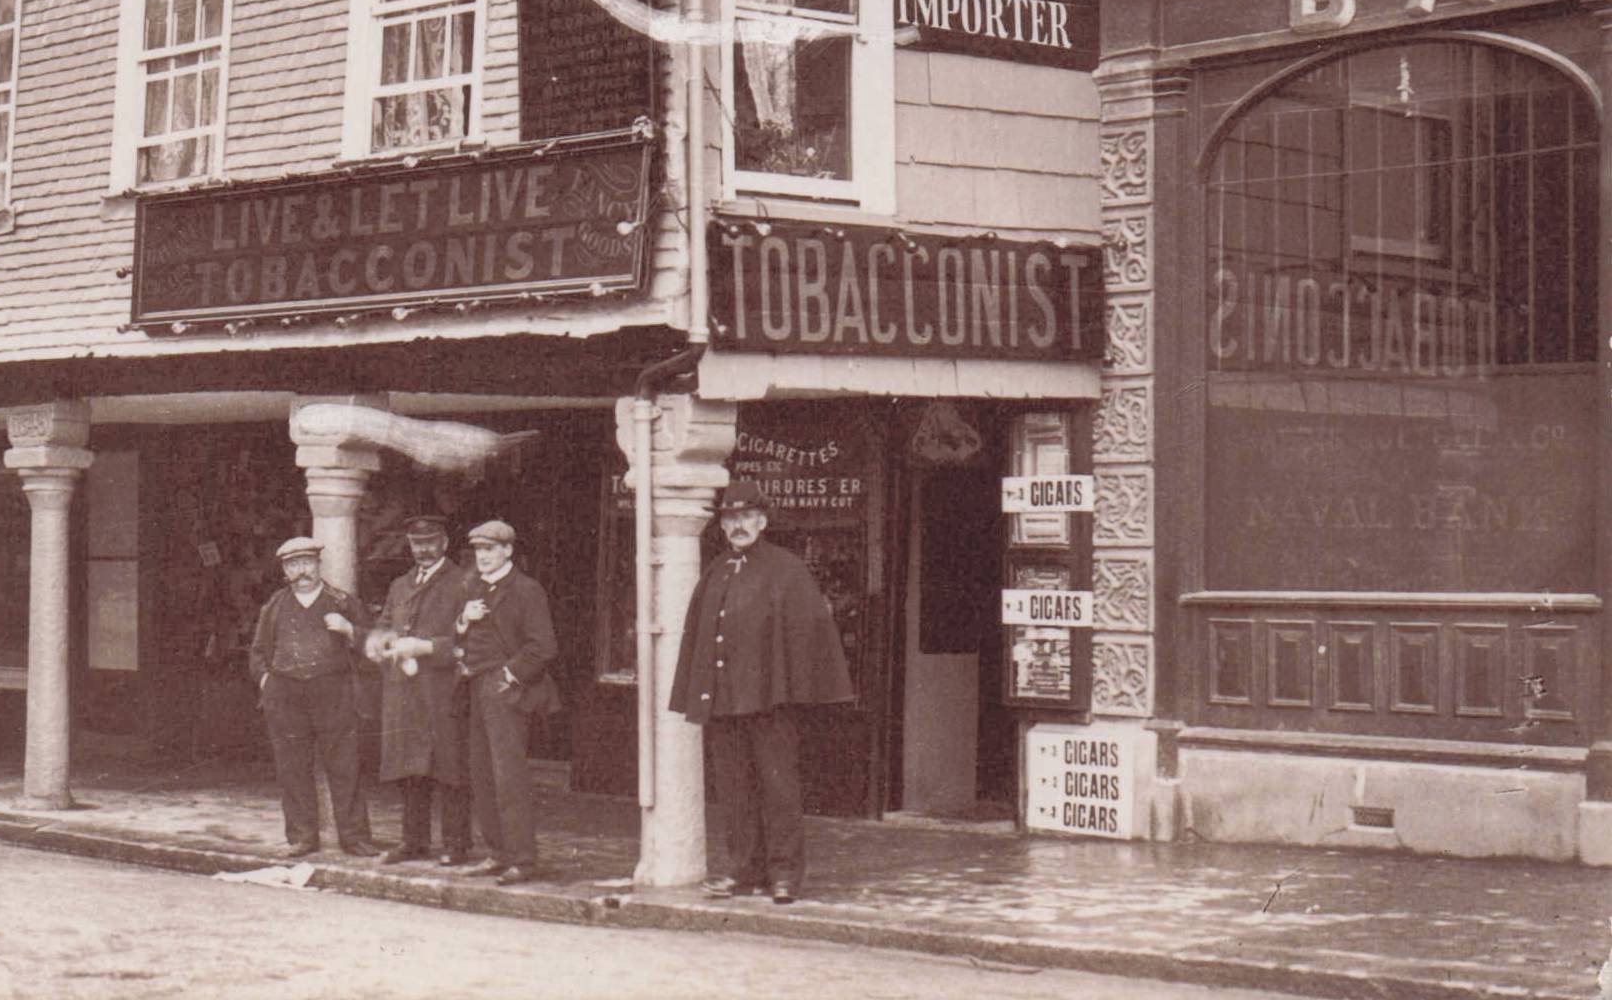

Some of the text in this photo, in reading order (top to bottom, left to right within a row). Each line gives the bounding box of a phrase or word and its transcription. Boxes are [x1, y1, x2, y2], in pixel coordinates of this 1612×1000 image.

[213, 197, 306, 250] LIVE
[311, 196, 341, 240] &
[350, 180, 439, 236] LET
[449, 163, 555, 228] LIVE
[194, 226, 575, 305] TOBACCONIST
[722, 235, 1088, 350] TOBACCONIST
[737, 432, 838, 466] CIGARETTES
[1065, 740, 1118, 767] CIGARS
[1065, 772, 1119, 800] CIGARS
[1064, 802, 1117, 833] CIGARS
